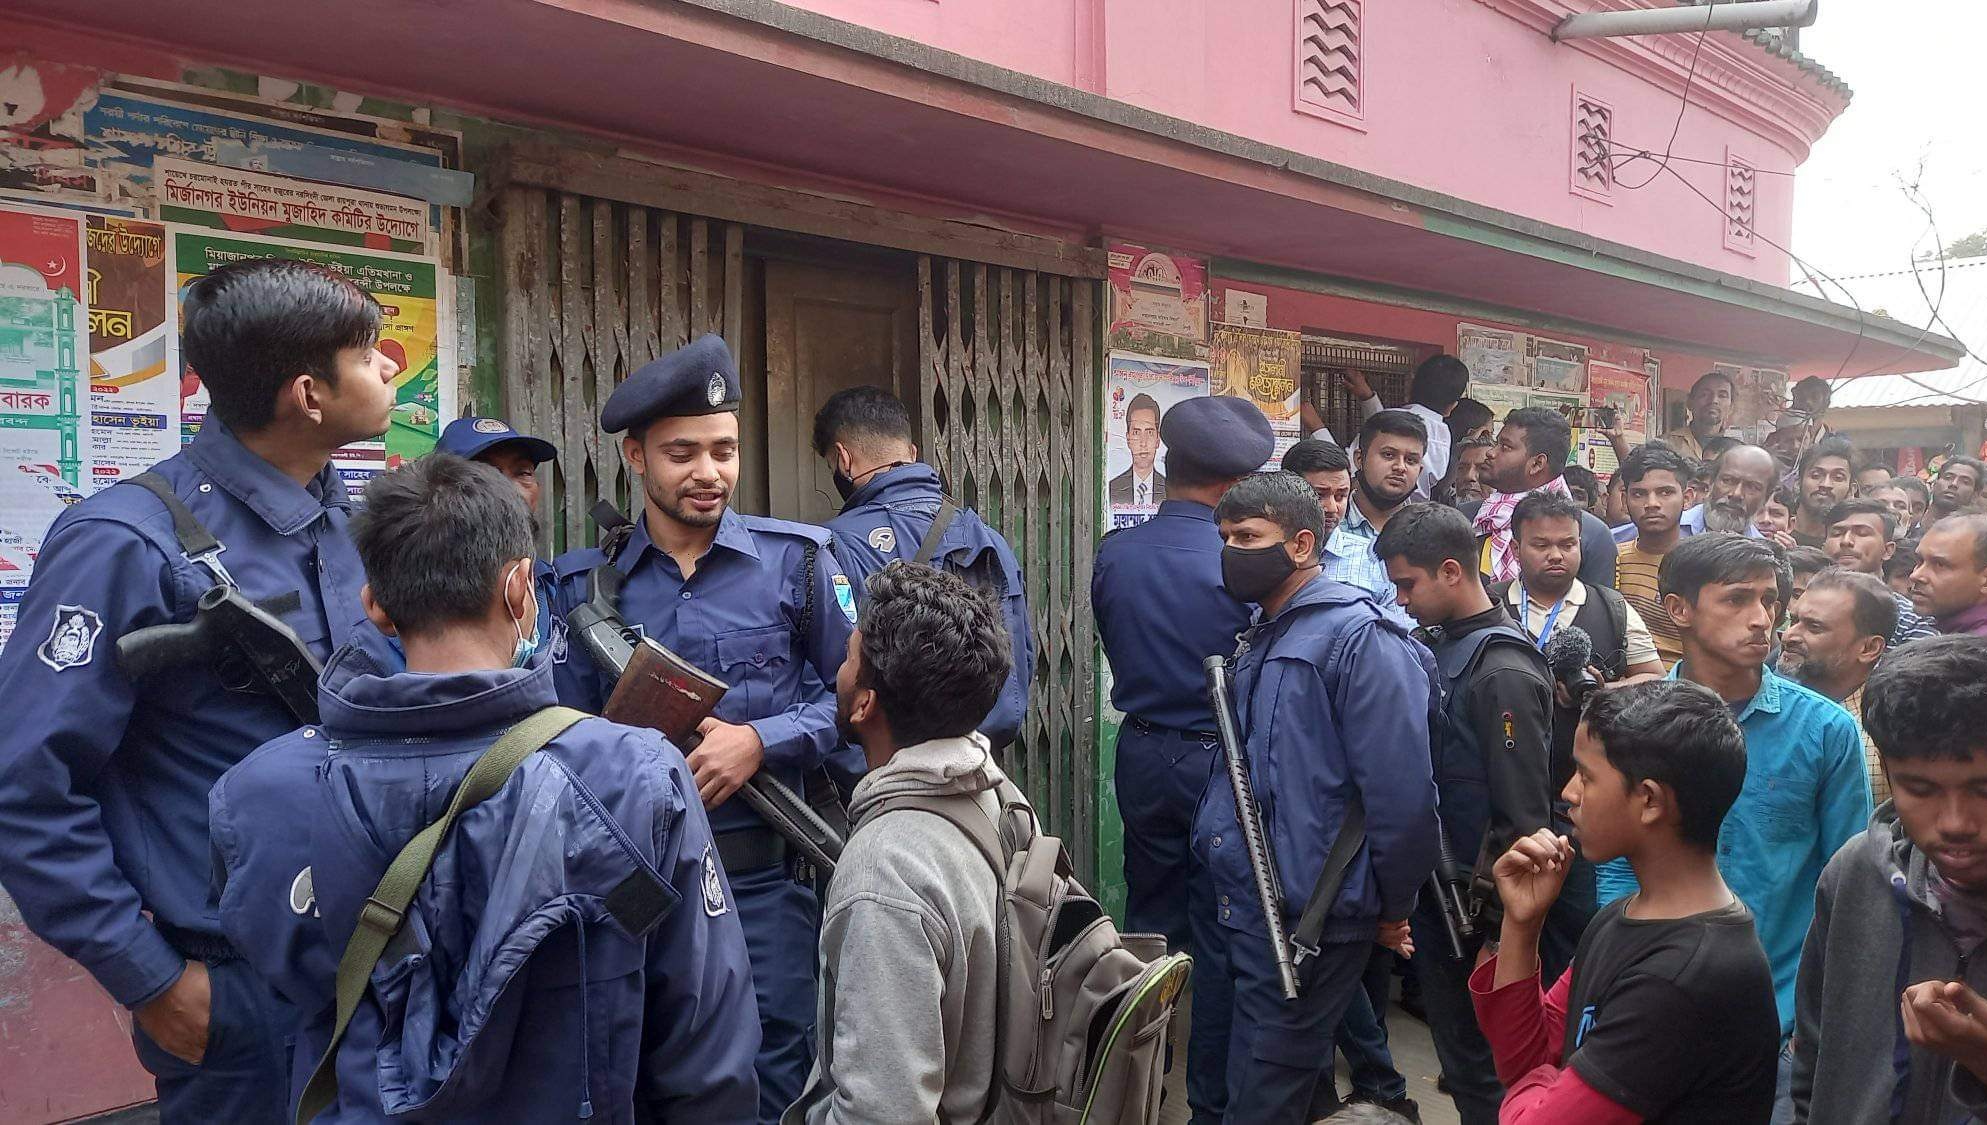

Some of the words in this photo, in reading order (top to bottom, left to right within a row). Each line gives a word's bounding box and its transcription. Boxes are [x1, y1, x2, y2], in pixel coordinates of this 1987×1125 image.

[220, 178, 239, 187] হযরত
[240, 179, 251, 190] পীর
[164, 178, 224, 210] মির্জানগর
[227, 187, 279, 217] ইউনিয়ন
[281, 201, 328, 227] মুজাহিদ
[330, 206, 372, 231] কমিটির
[375, 211, 420, 239] উদ্যোগে
[118, 223, 161, 260] উদ্যোগে
[356, 264, 402, 281] এতিমখানা
[405, 273, 413, 281] ও
[88, 308, 132, 339] লন
[0, 391, 51, 410] বারক
[343, 471, 371, 480] সাহেব
